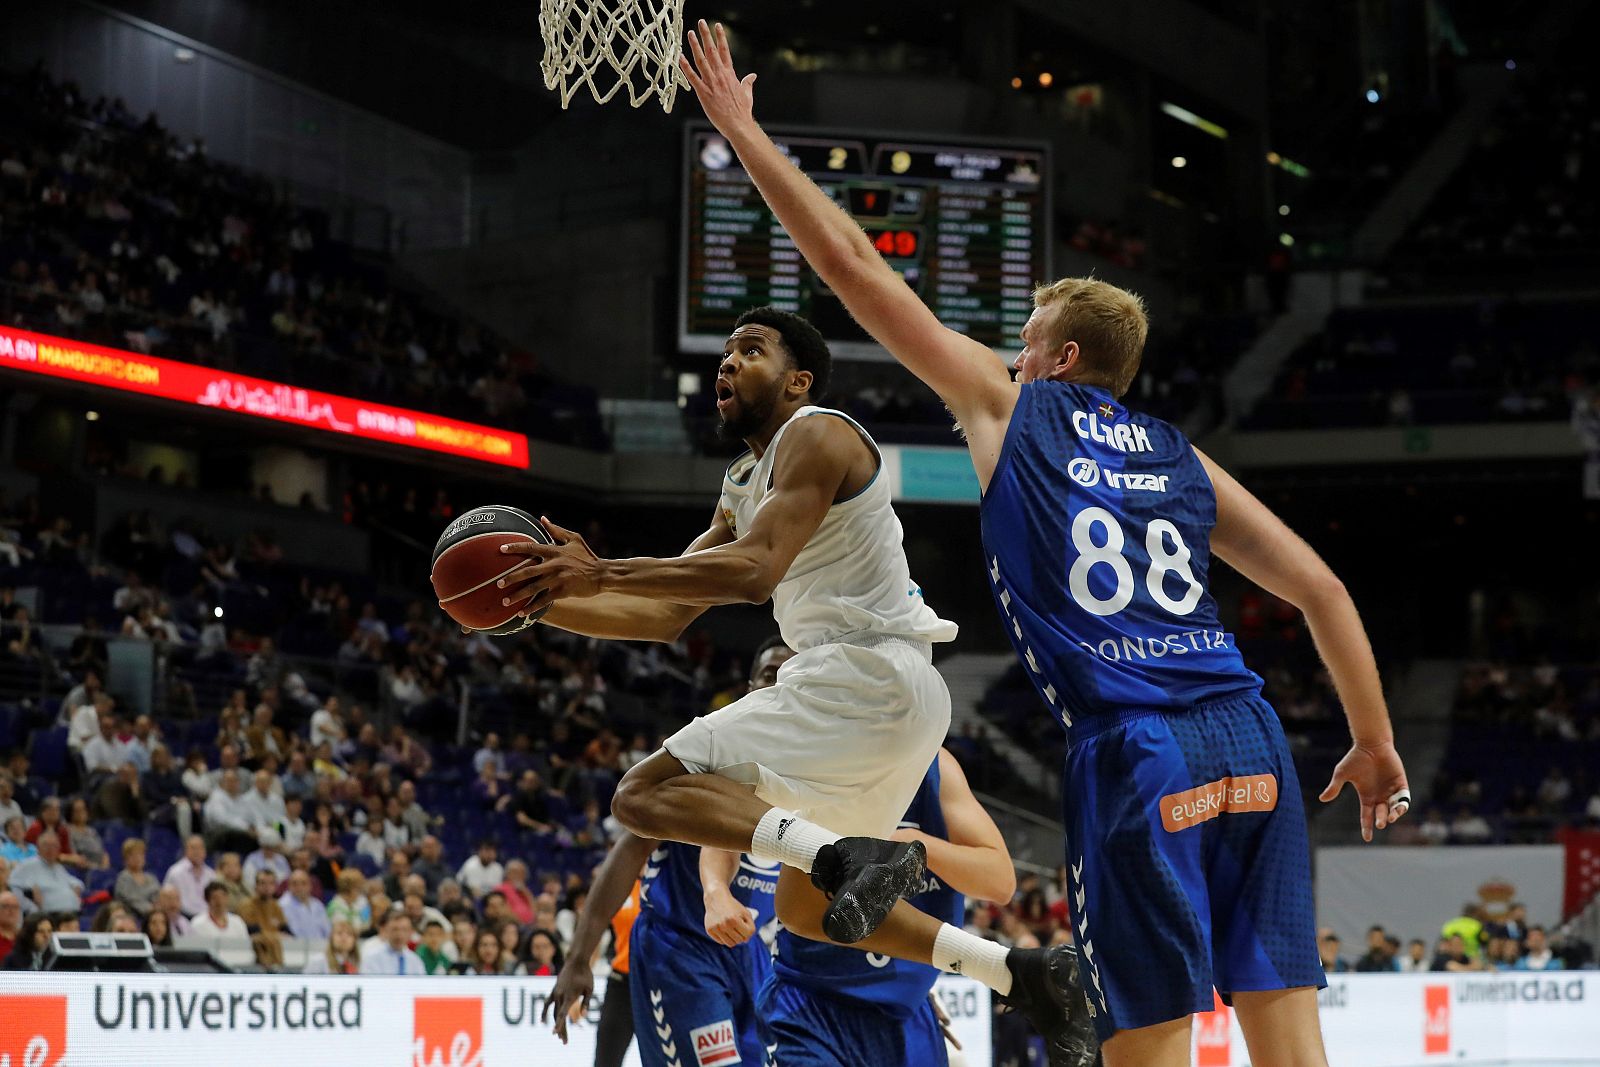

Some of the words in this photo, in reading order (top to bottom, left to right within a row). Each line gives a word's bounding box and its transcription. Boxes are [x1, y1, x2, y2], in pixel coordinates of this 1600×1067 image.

[1072, 410, 1153, 452] CLARK
[1069, 507, 1203, 616] 88
[94, 985, 363, 1030] Universidad
